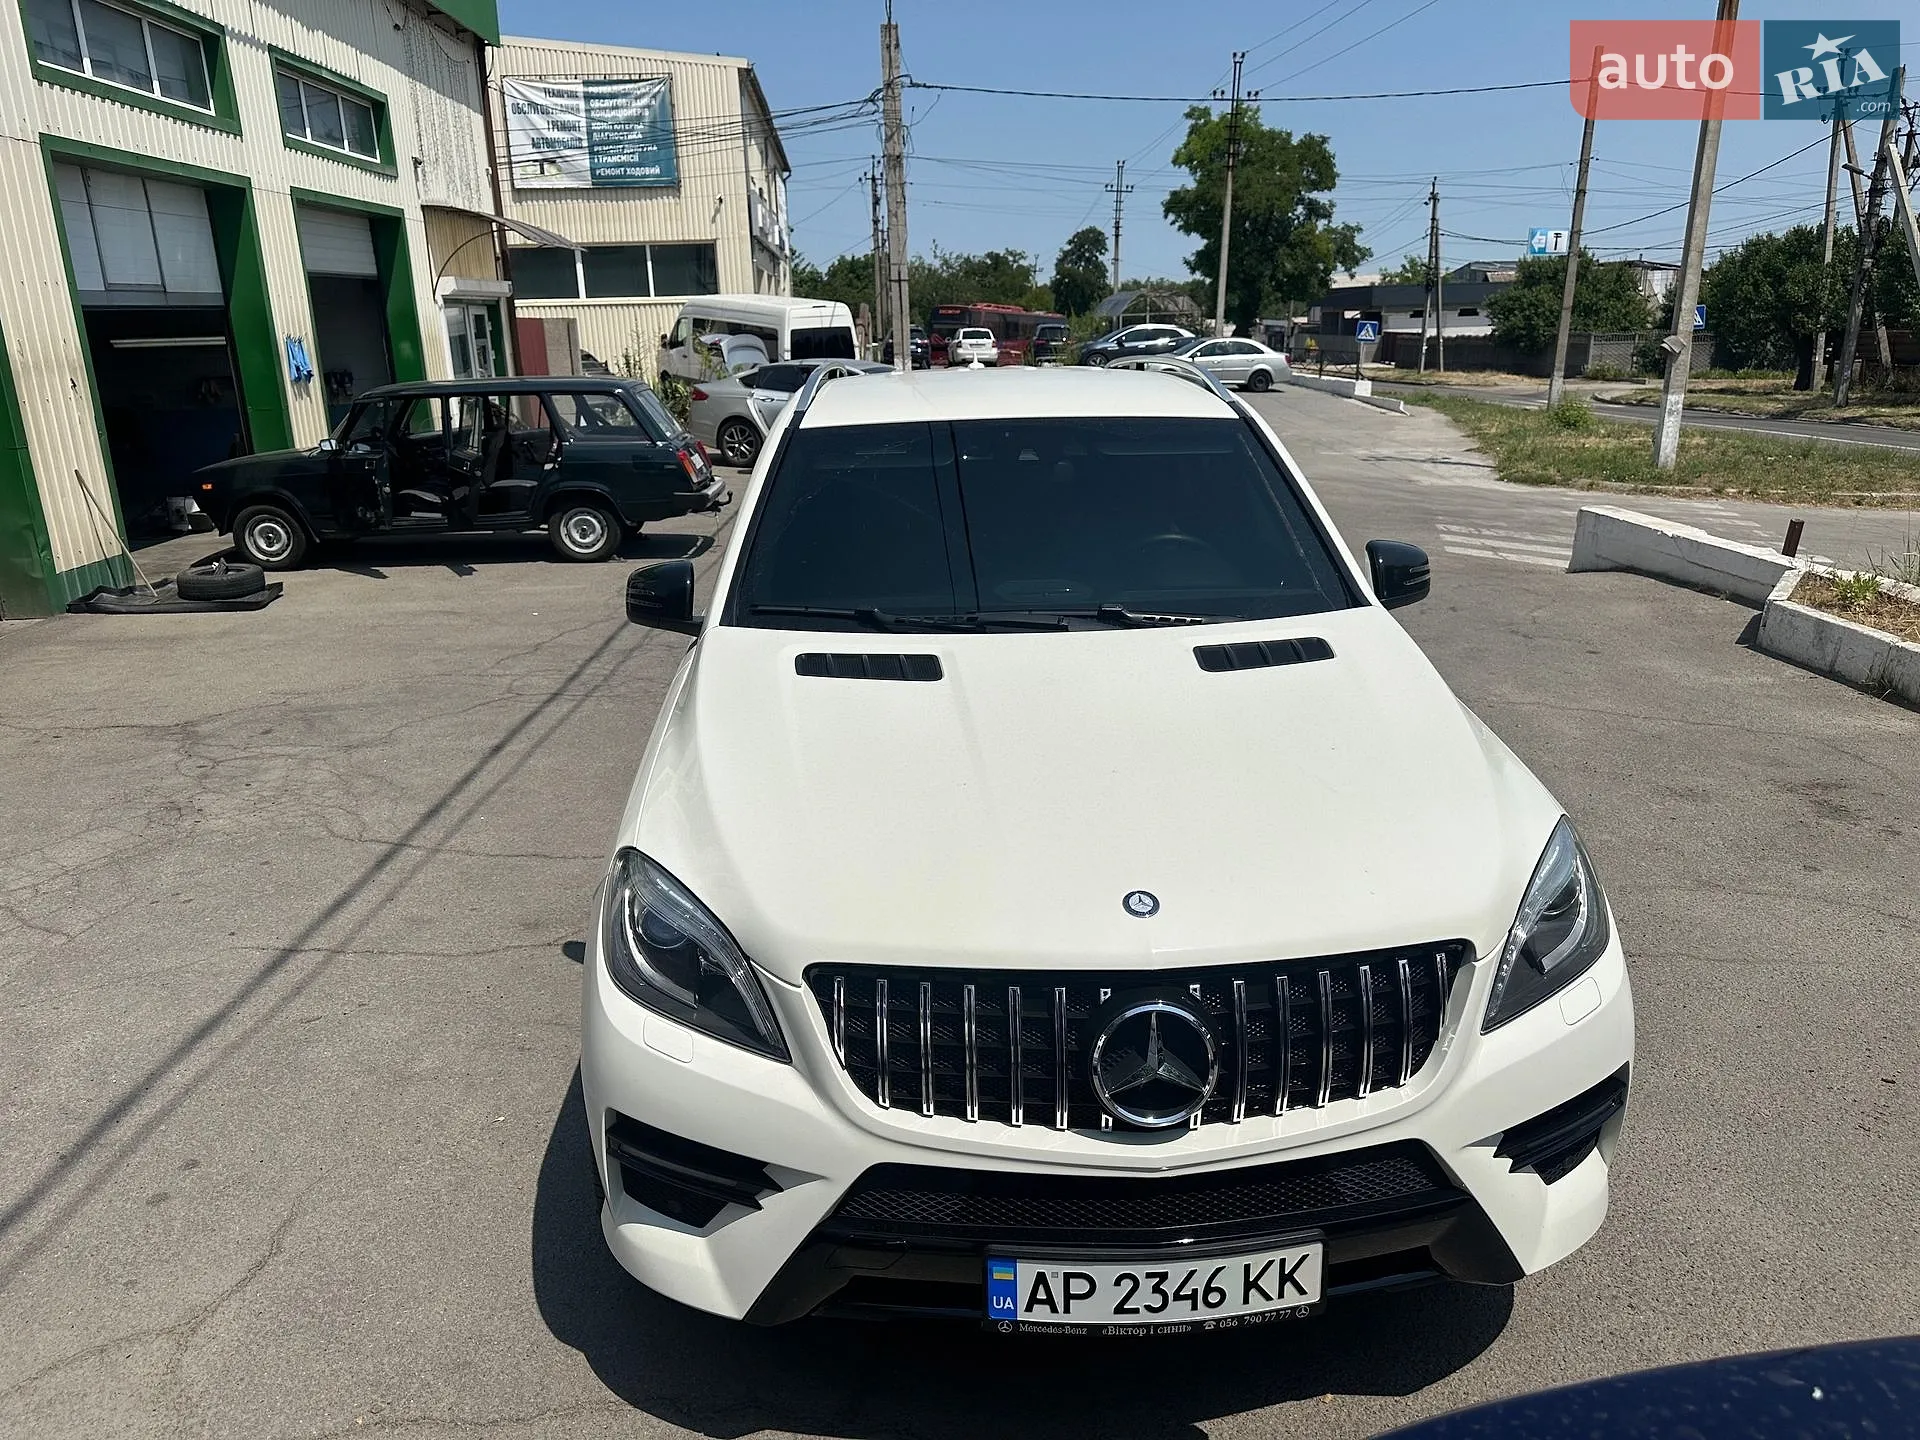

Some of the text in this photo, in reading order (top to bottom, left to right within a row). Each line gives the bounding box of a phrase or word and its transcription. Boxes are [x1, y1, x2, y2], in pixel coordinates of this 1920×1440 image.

[552, 120, 581, 132] РЕМОНТ
[532, 137, 583, 149] АВТОМОБІЛІВ
[596, 165, 660, 177] РЕМОНТ ХОДОВИЙ
[1023, 1253, 1310, 1315] AP 2346 KK
[993, 1296, 1015, 1310] UA
[1219, 1309, 1291, 1329] 056 790 77 77
[1019, 1323, 1088, 1335] Mercedes-Benz
